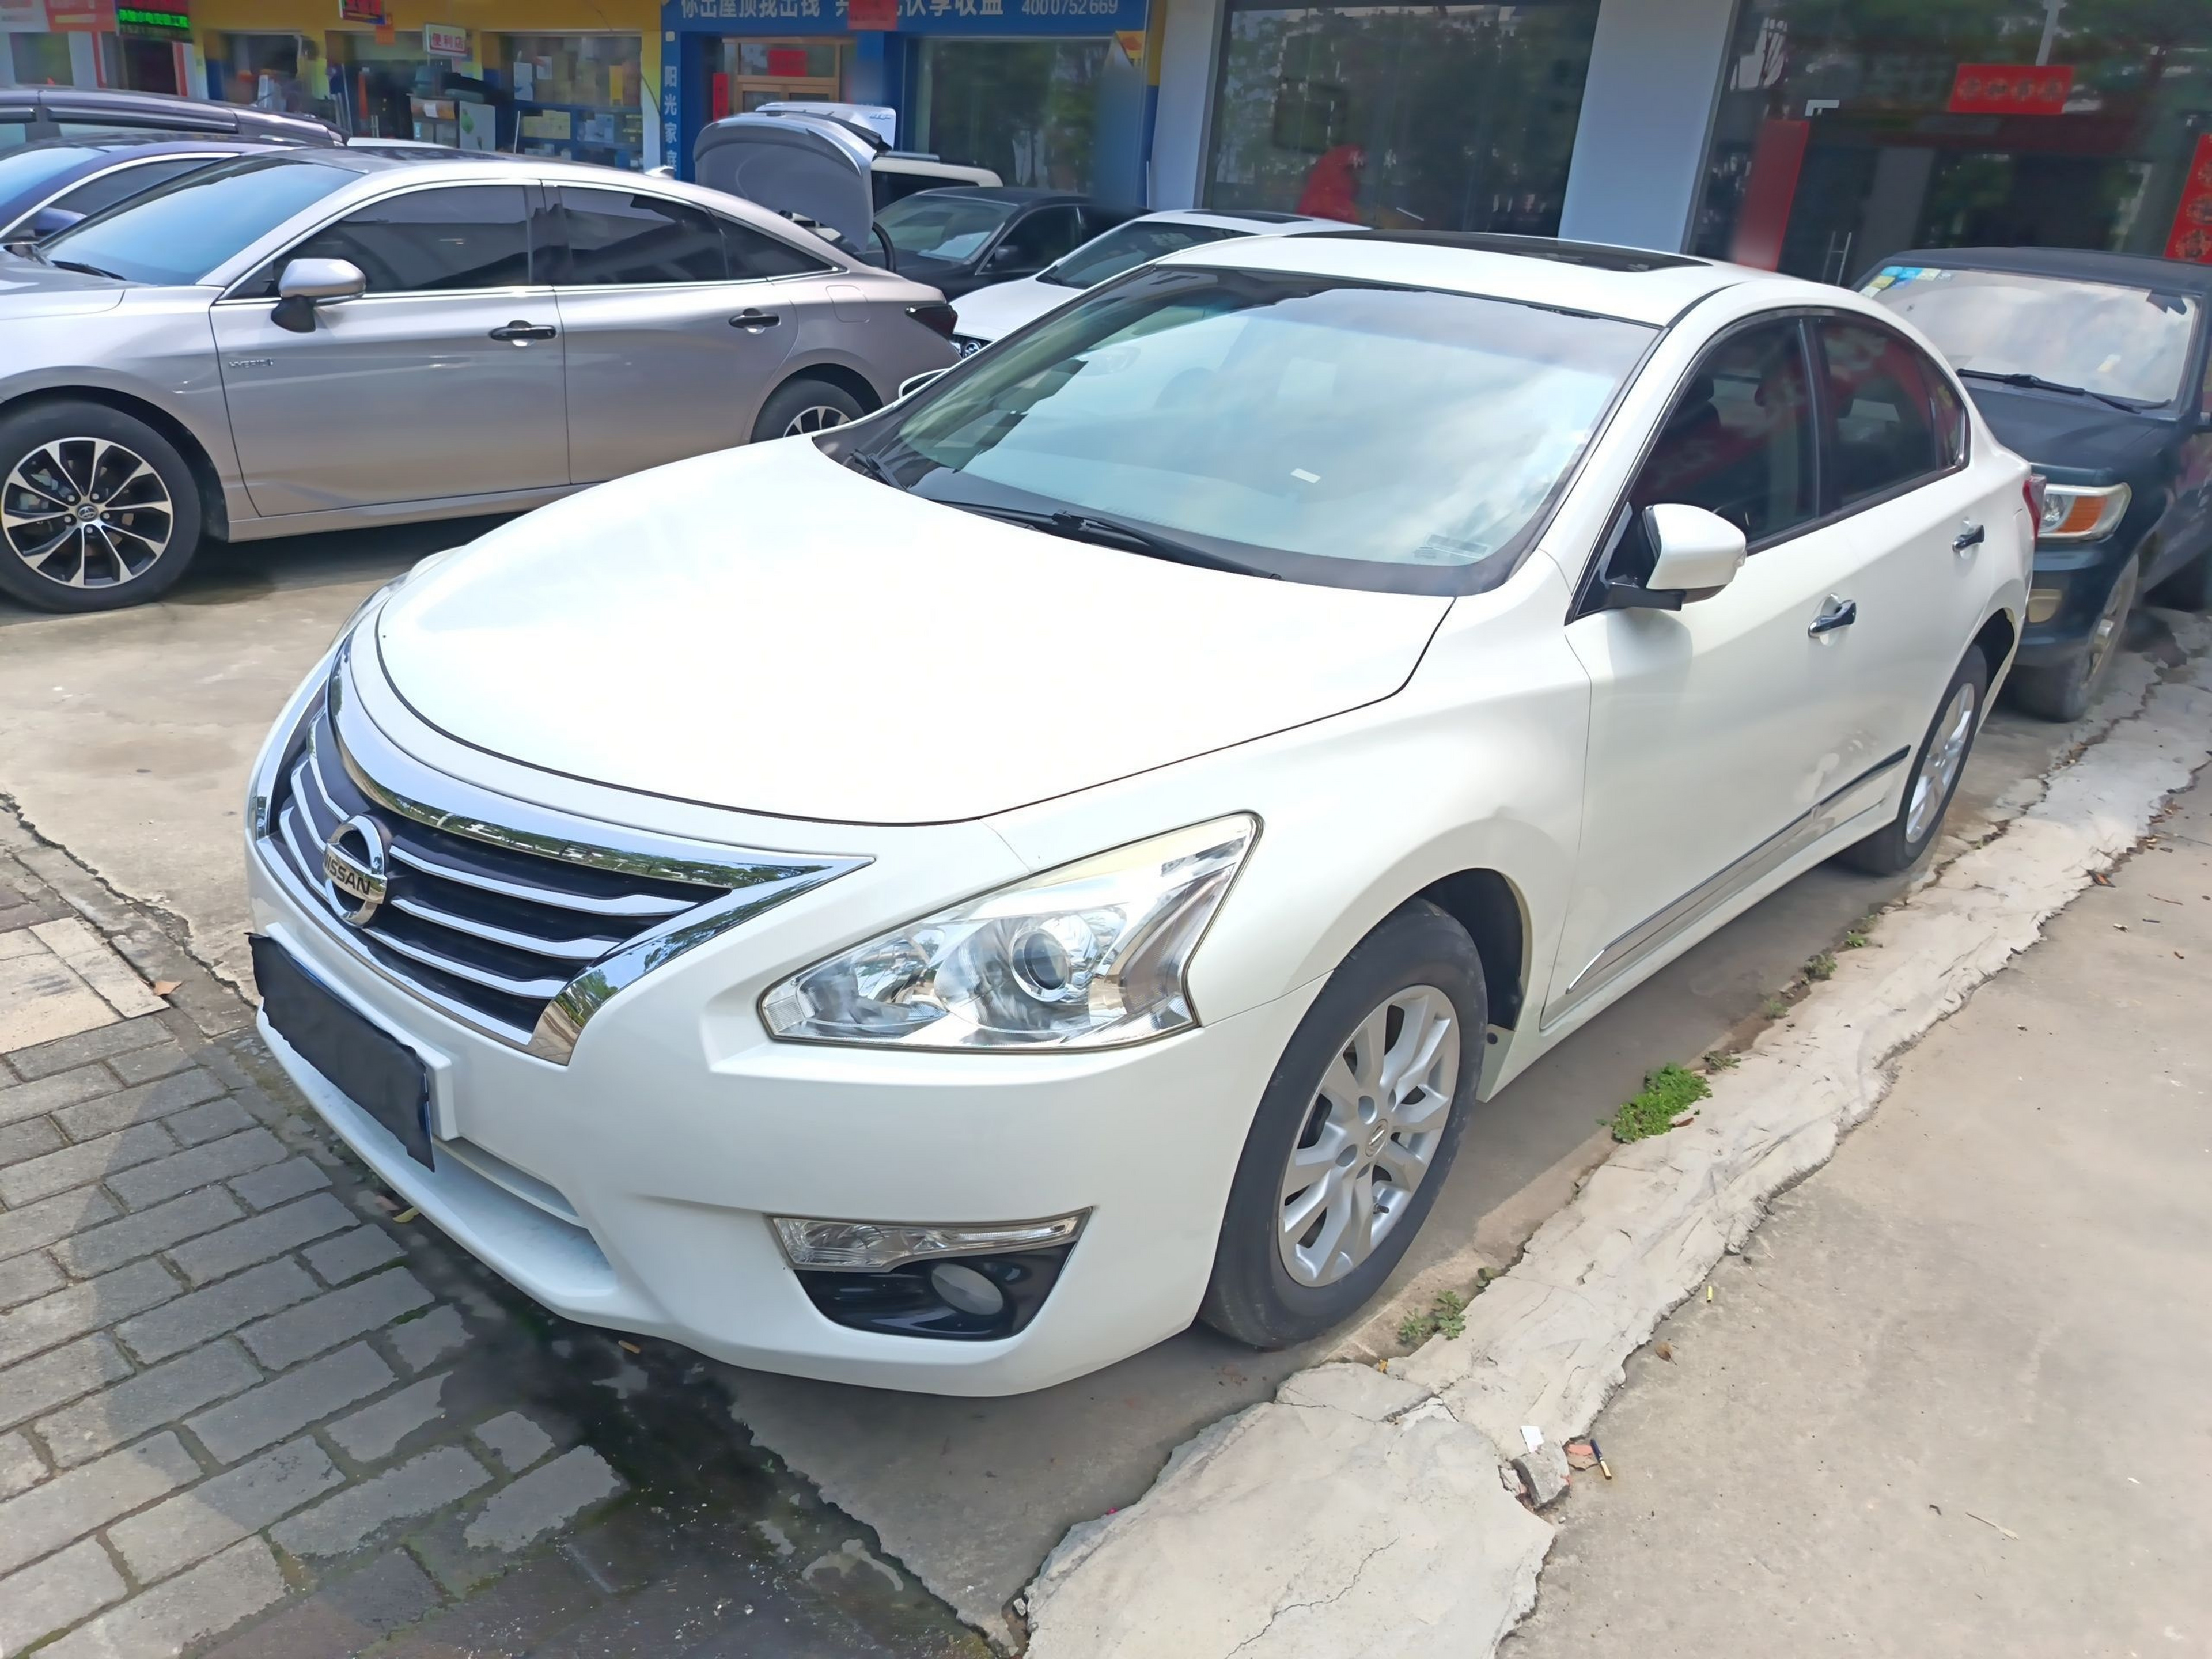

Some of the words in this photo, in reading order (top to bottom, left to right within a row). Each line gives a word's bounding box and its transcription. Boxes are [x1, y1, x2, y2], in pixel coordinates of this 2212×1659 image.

[433, 33, 464, 50] 便利店
[324, 854, 371, 895] NISSAN
